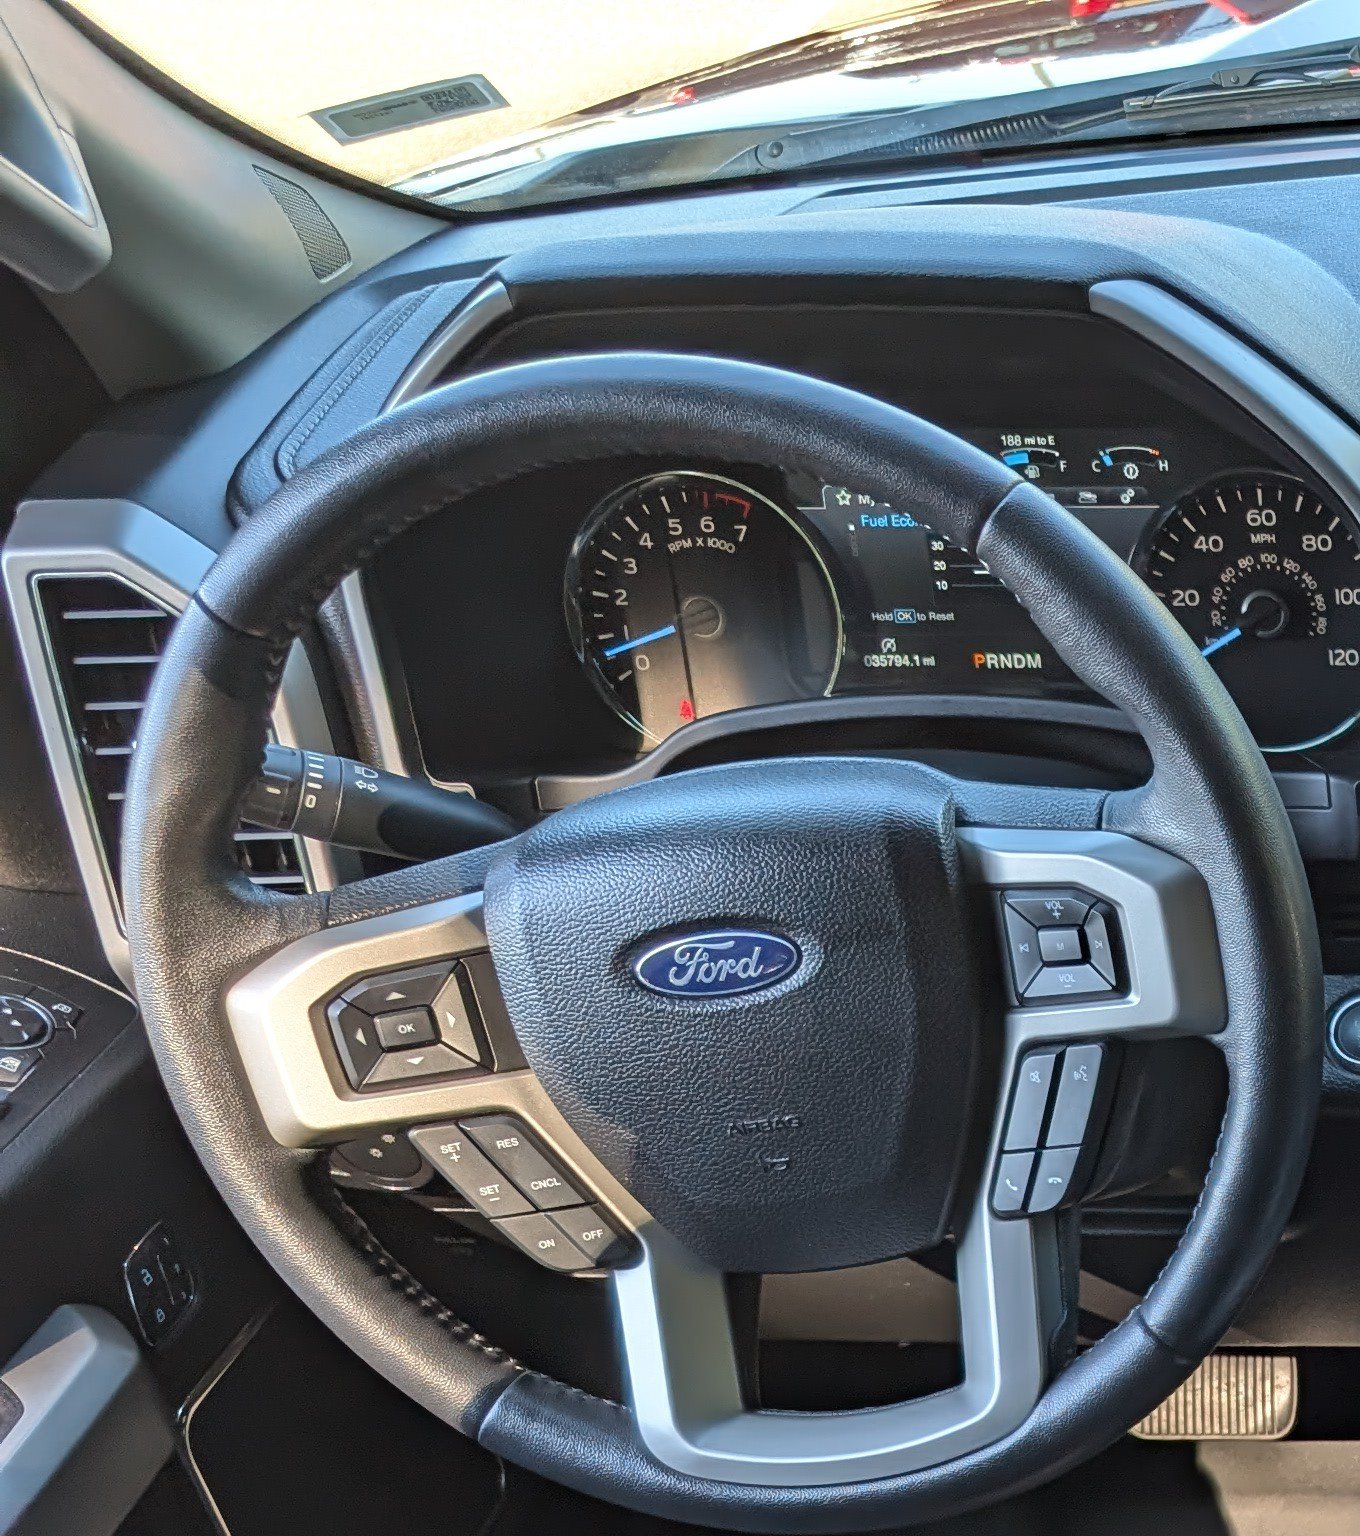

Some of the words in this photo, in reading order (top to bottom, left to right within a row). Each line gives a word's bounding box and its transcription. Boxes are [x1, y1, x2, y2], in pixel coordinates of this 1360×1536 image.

[1000, 434, 1022, 446] 188
[1024, 435, 1036, 445] mi
[1037, 435, 1047, 445] to
[1048, 435, 1056, 445] E
[1059, 460, 1068, 472] F
[1091, 460, 1100, 472] C
[1158, 459, 1169, 472] H
[860, 514, 889, 527] Fuel
[1246, 509, 1277, 526] 60
[668, 518, 683, 536] 5
[699, 516, 715, 533] 6
[733, 525, 748, 542] 7
[1250, 533, 1277, 544] MPH
[638, 532, 654, 550] 4
[668, 537, 693, 553] RPM
[707, 537, 736, 553] 1000
[931, 541, 944, 551] 30
[1193, 535, 1224, 553] 40
[1301, 534, 1333, 552] 80
[1237, 555, 1255, 569] 80
[1259, 552, 1278, 564] 100
[622, 557, 638, 575] 3
[933, 561, 947, 571] 20
[1283, 557, 1300, 573] 120
[1220, 567, 1236, 583] 60
[936, 580, 948, 591] 10
[614, 588, 629, 606] 2
[1171, 588, 1200, 607] 20
[1211, 585, 1224, 604] 40
[871, 611, 894, 621] Hold
[897, 612, 914, 621] OK
[917, 611, 927, 621] to
[928, 611, 955, 621] Reset
[1210, 609, 1222, 627] 20
[635, 654, 650, 671] 0
[863, 654, 921, 667] 035794.1
[922, 655, 936, 667] mi
[1328, 648, 1360, 667] 120
[1044, 900, 1065, 910] VOL
[668, 940, 764, 987] Ford
[1058, 973, 1076, 983] VOL
[397, 1022, 416, 1035] OK
[440, 1141, 462, 1154] SET
[496, 1137, 520, 1150] RES
[479, 1184, 500, 1196] SET
[530, 1177, 562, 1191] CNCL
[582, 1229, 604, 1241] OFF
[538, 1238, 556, 1250] ON
